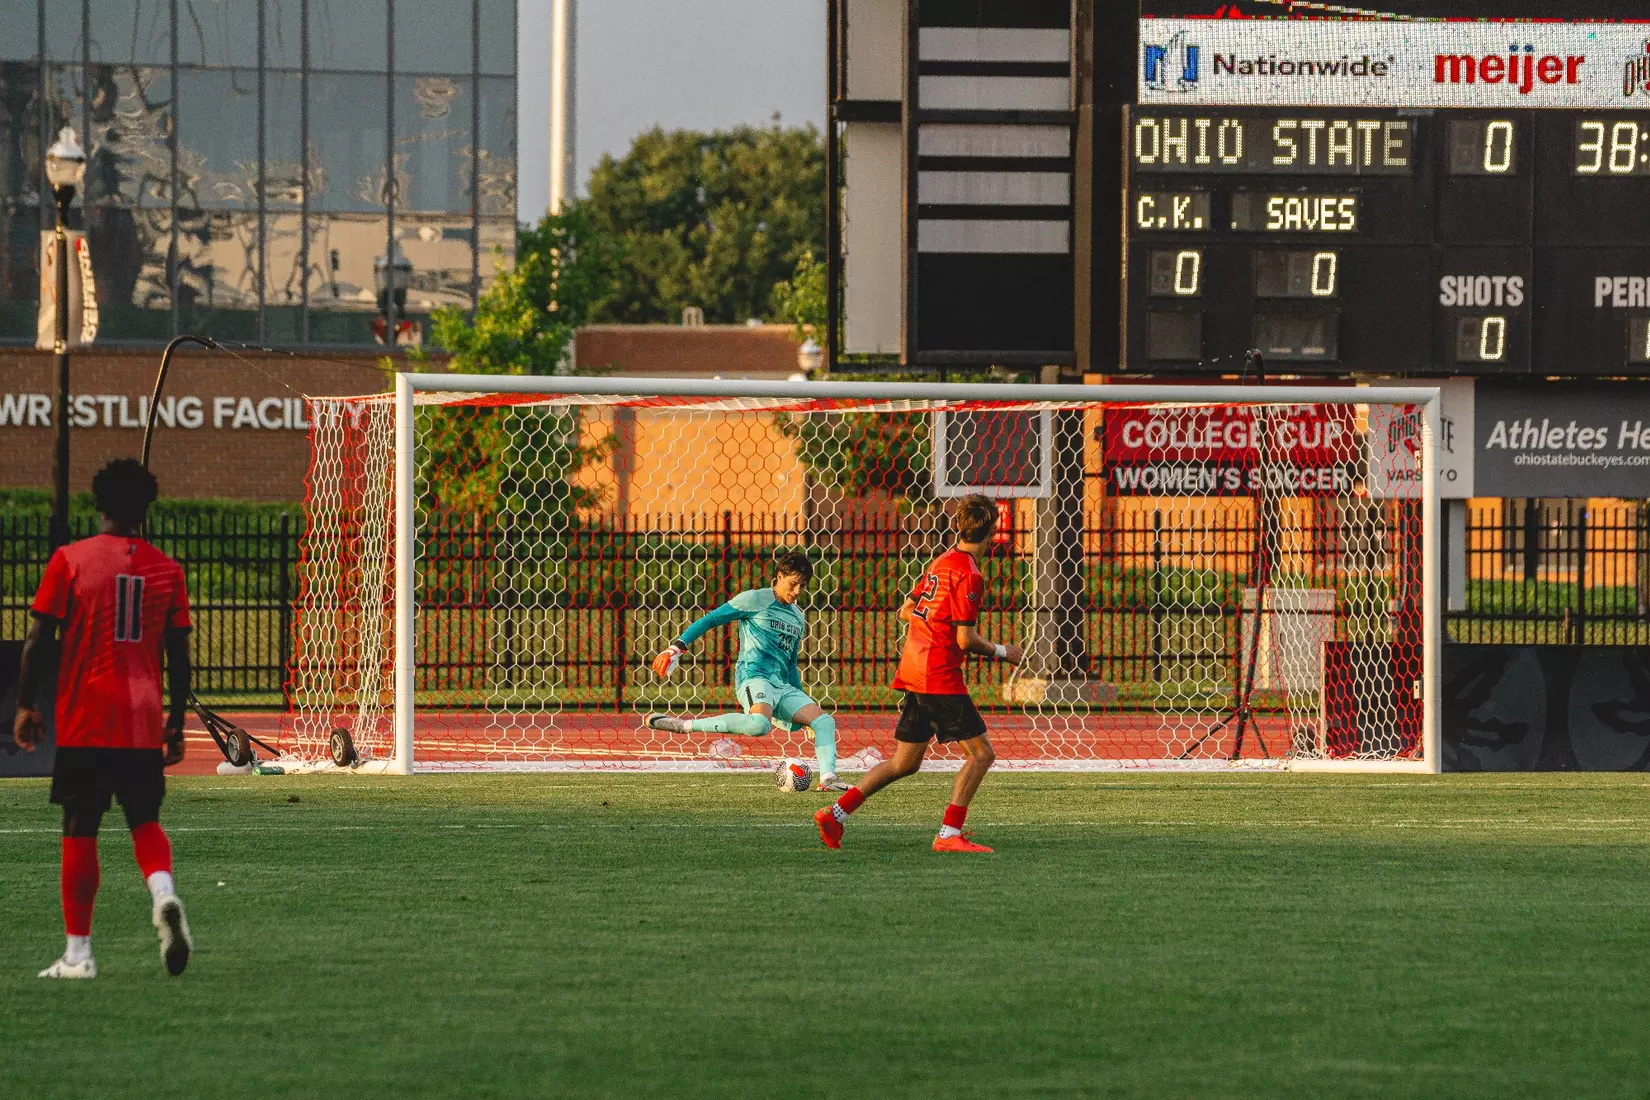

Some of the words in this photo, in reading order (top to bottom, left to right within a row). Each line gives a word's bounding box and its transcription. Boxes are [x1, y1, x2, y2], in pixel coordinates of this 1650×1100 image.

[1213, 54, 1390, 77] Nationwide
[1434, 44, 1585, 95] meijer
[1135, 118, 1243, 164] OHIO
[1272, 119, 1408, 166] STATE
[1483, 121, 1513, 172] 0
[1266, 197, 1355, 230] SAVES
[1173, 251, 1200, 295] 0
[1311, 252, 1337, 296] 0
[1439, 275, 1524, 307] SHOTS
[1479, 316, 1505, 359] 0
[1121, 420, 1264, 449] COLLEGE
[1277, 421, 1343, 449] CUP
[1485, 418, 1608, 450] Athletes
[1115, 467, 1240, 490] WOMEN'S
[1247, 467, 1349, 491] SOCCER
[114, 573, 146, 642] 11
